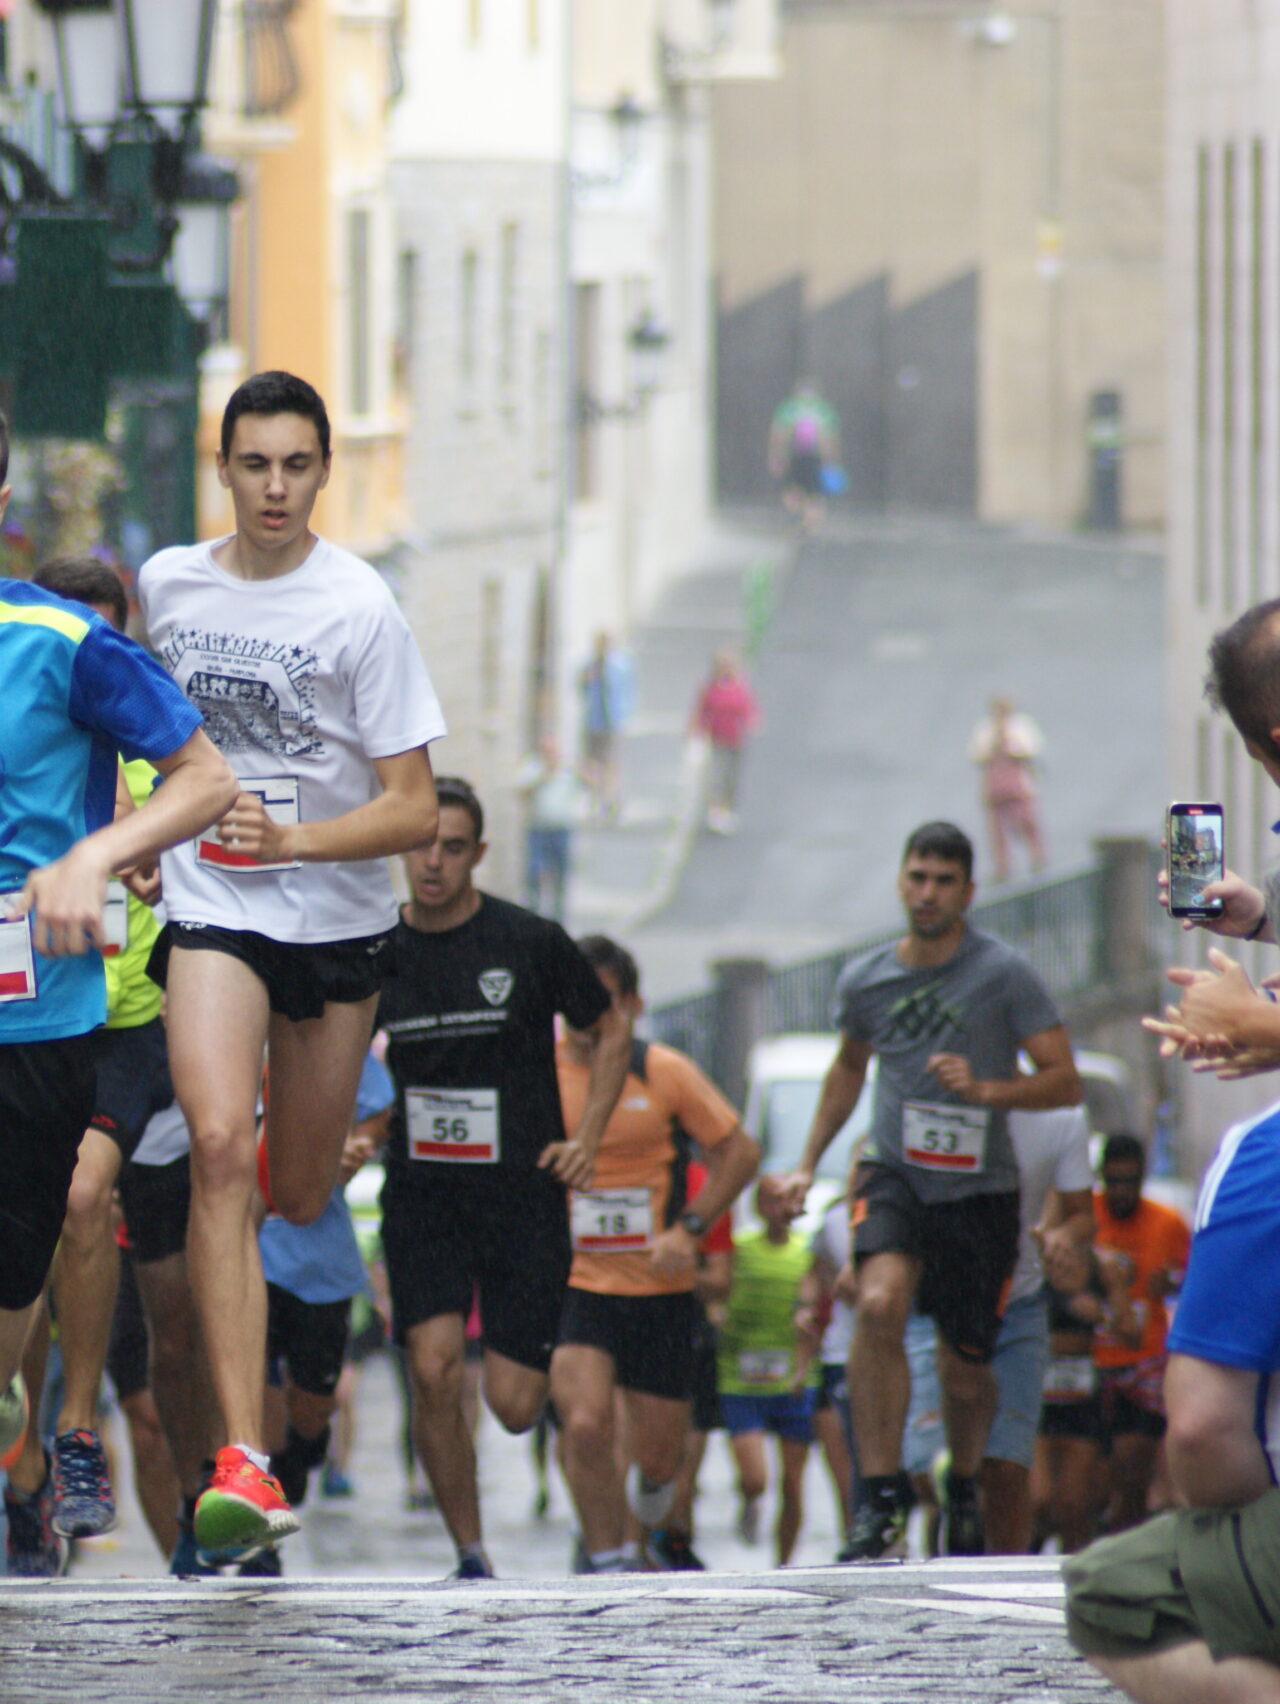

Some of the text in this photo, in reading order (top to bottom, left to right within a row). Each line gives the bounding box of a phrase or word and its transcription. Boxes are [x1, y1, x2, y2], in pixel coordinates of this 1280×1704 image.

[433, 1117, 469, 1142] 56
[924, 1129, 959, 1151] 53
[597, 1213, 628, 1233] 18
